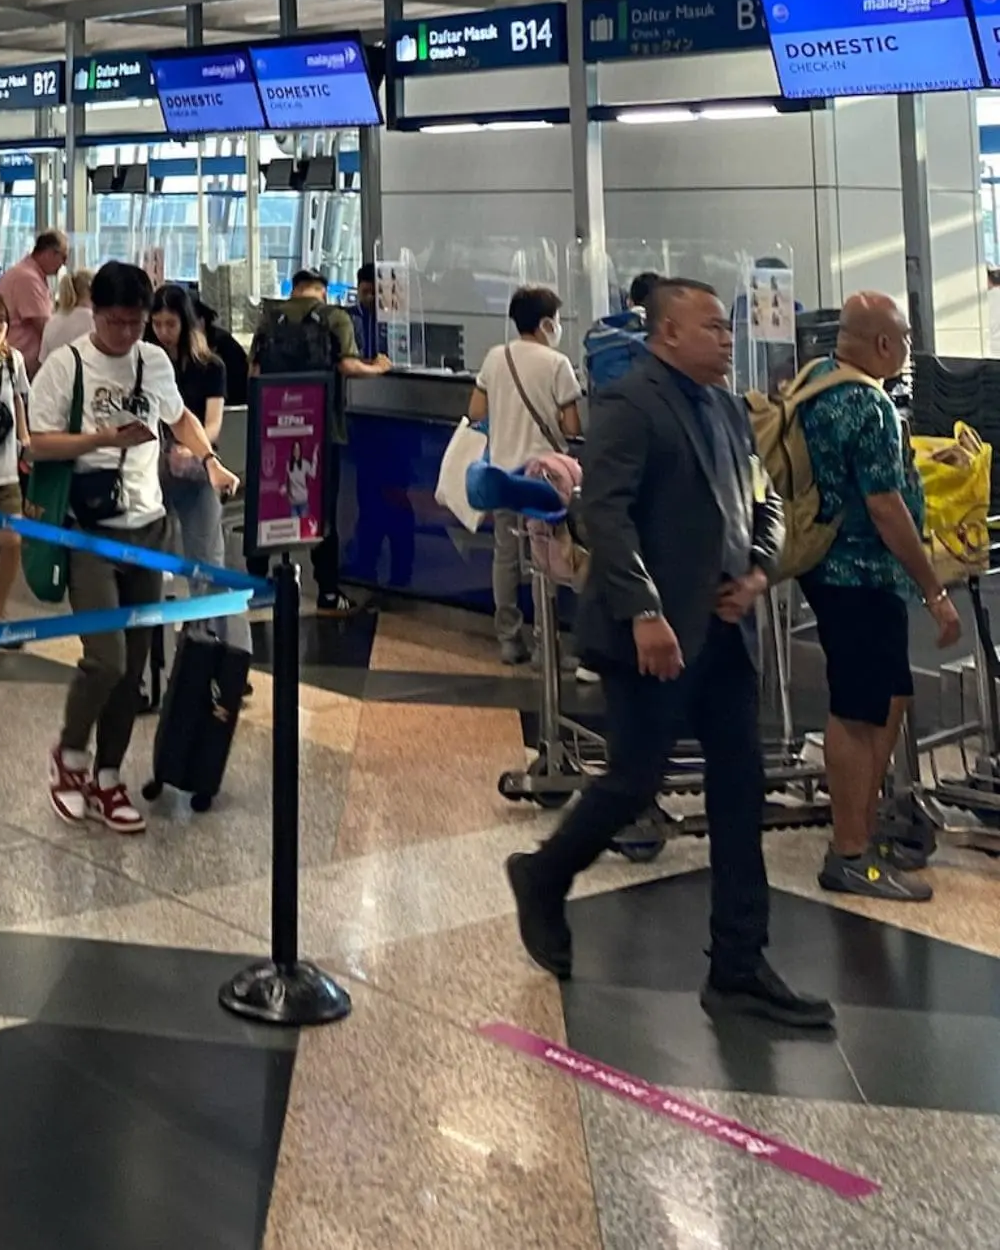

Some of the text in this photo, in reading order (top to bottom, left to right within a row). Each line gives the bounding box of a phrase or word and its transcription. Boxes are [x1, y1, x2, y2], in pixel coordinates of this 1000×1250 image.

[631, 2, 715, 24] Daftar Masuk
[429, 23, 498, 45] Daftar Masuk
[511, 18, 552, 52] B14
[785, 35, 899, 59] DOMESTIC
[789, 60, 846, 74] CHECK-IN
[33, 71, 57, 96] B12
[266, 84, 331, 100] DOMESTIC
[166, 93, 224, 109] DOMESTIC
